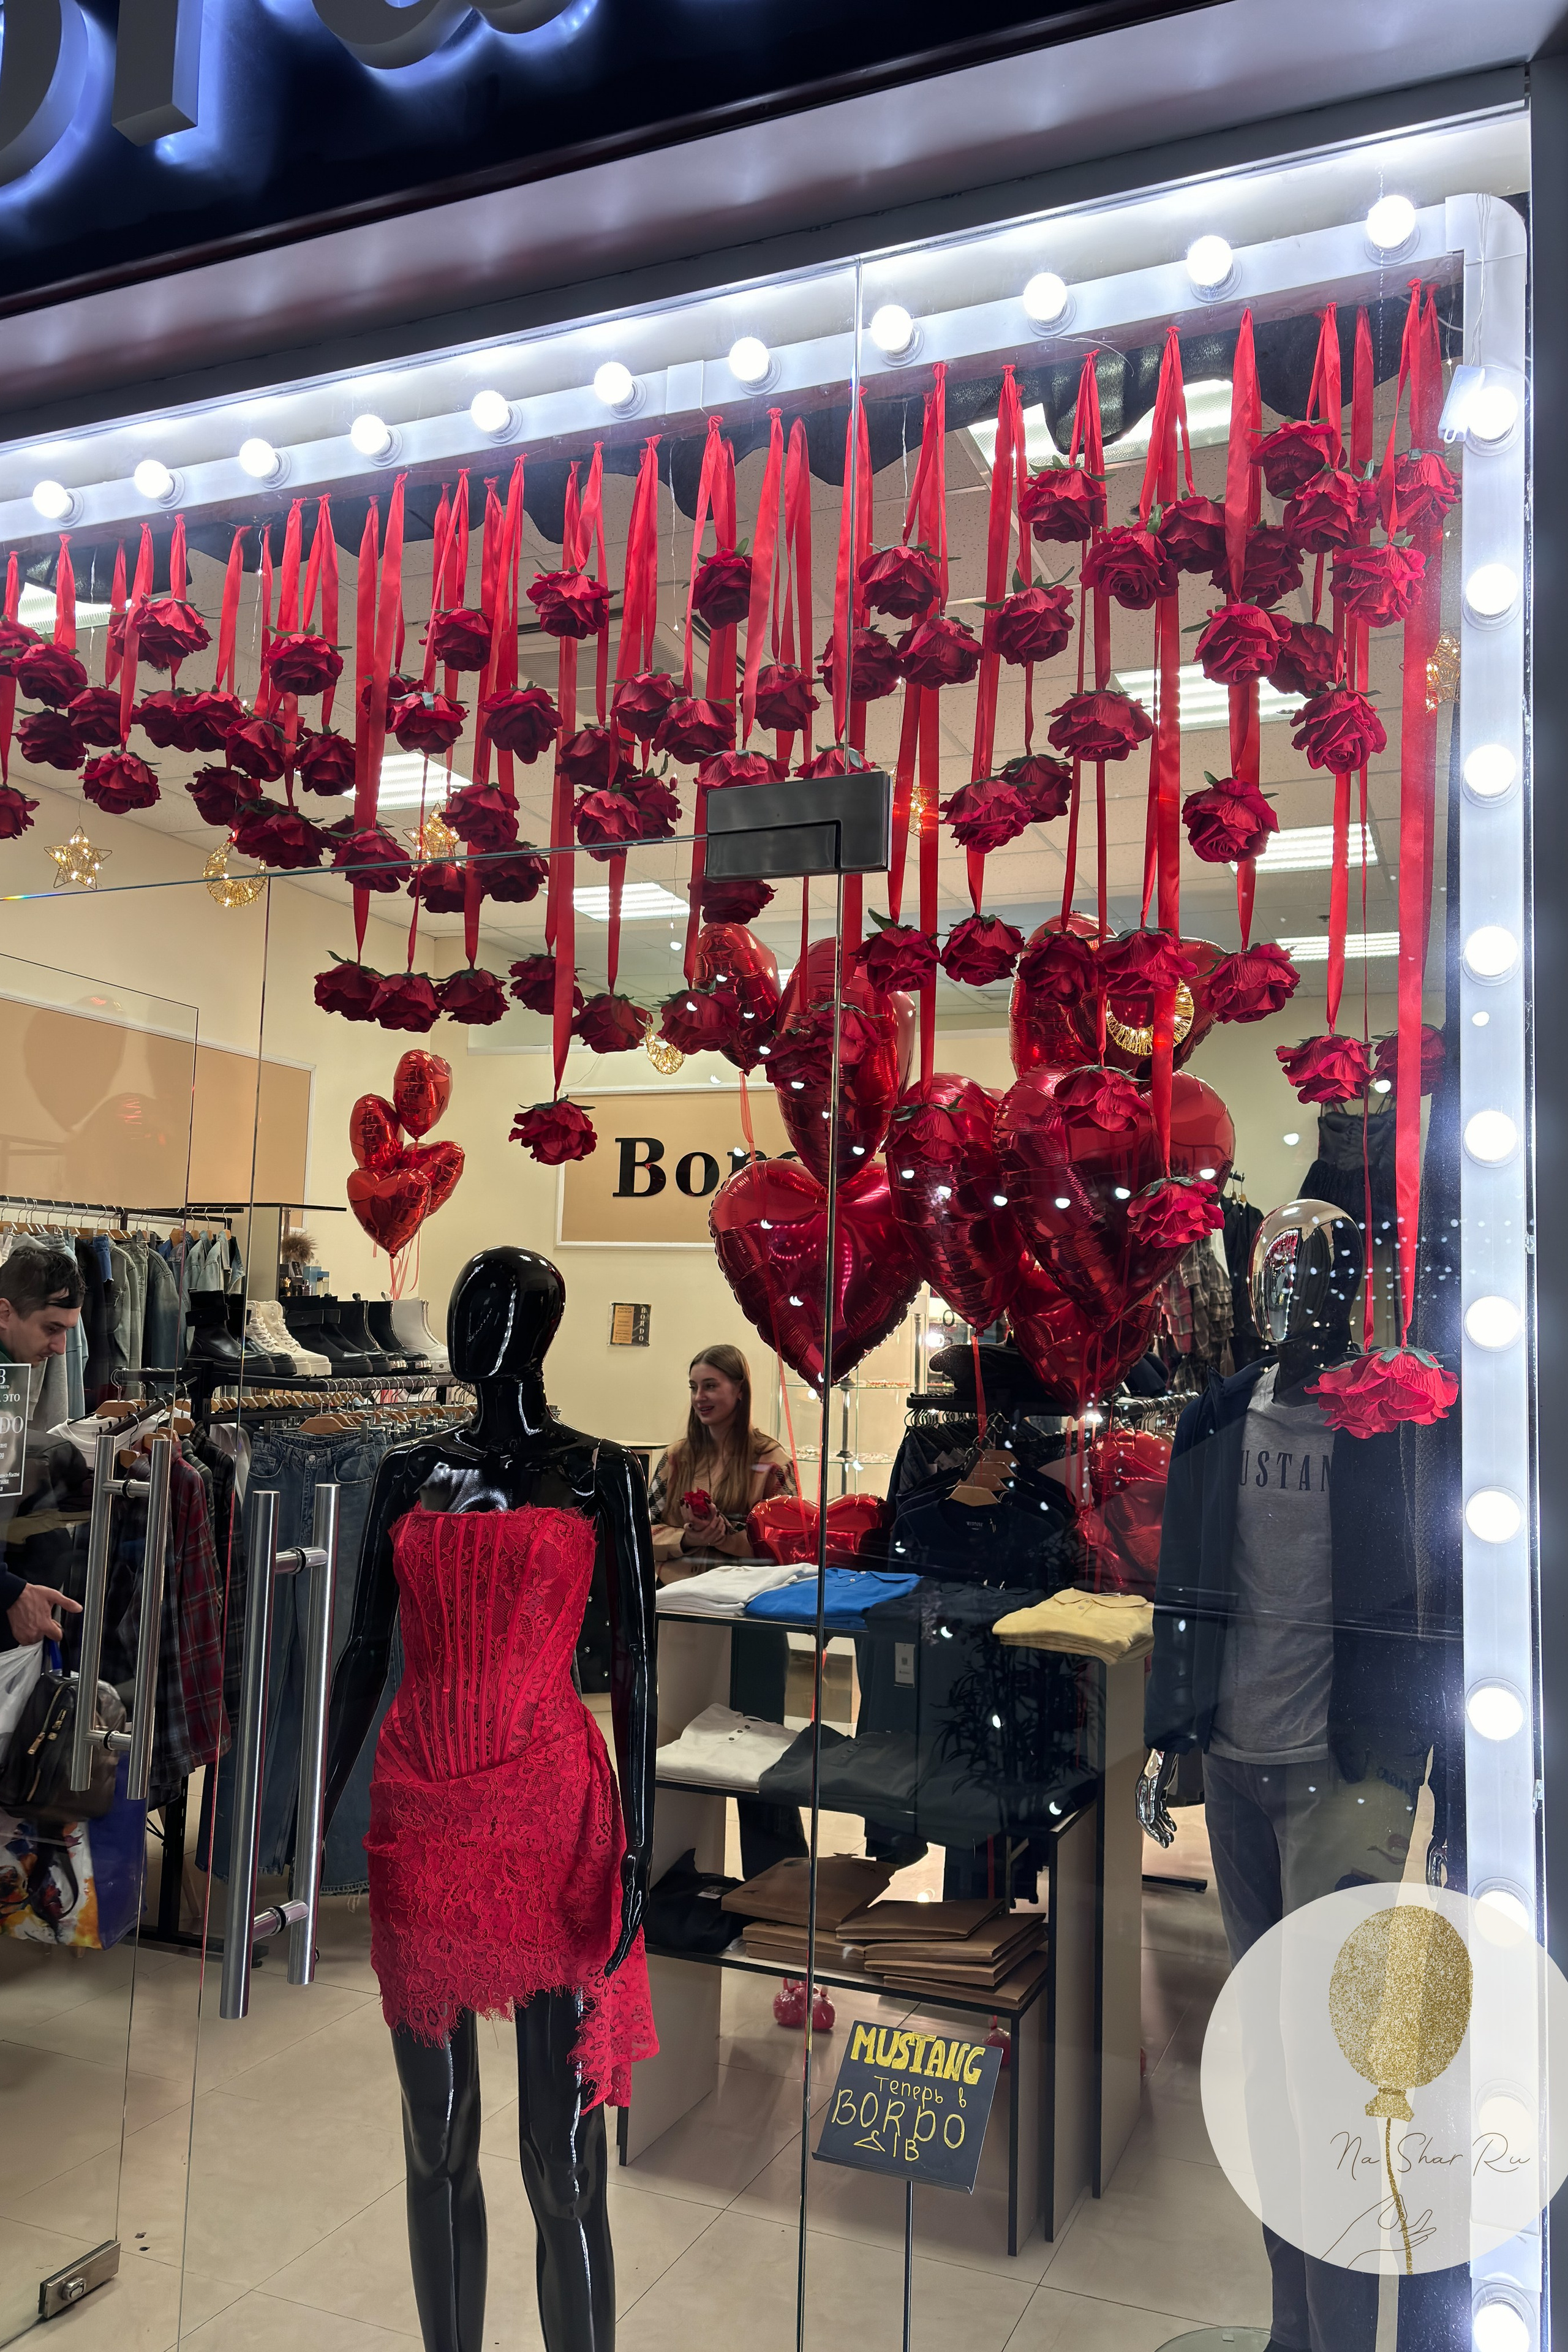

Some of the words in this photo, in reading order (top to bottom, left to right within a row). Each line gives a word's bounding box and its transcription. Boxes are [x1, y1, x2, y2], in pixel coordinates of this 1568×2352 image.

[612, 1137, 801, 1197] Bor
[2, 1393, 21, 1403] ЭТО
[850, 2024, 986, 2086] MUSTANG
[831, 2089, 966, 2149] BORDO
